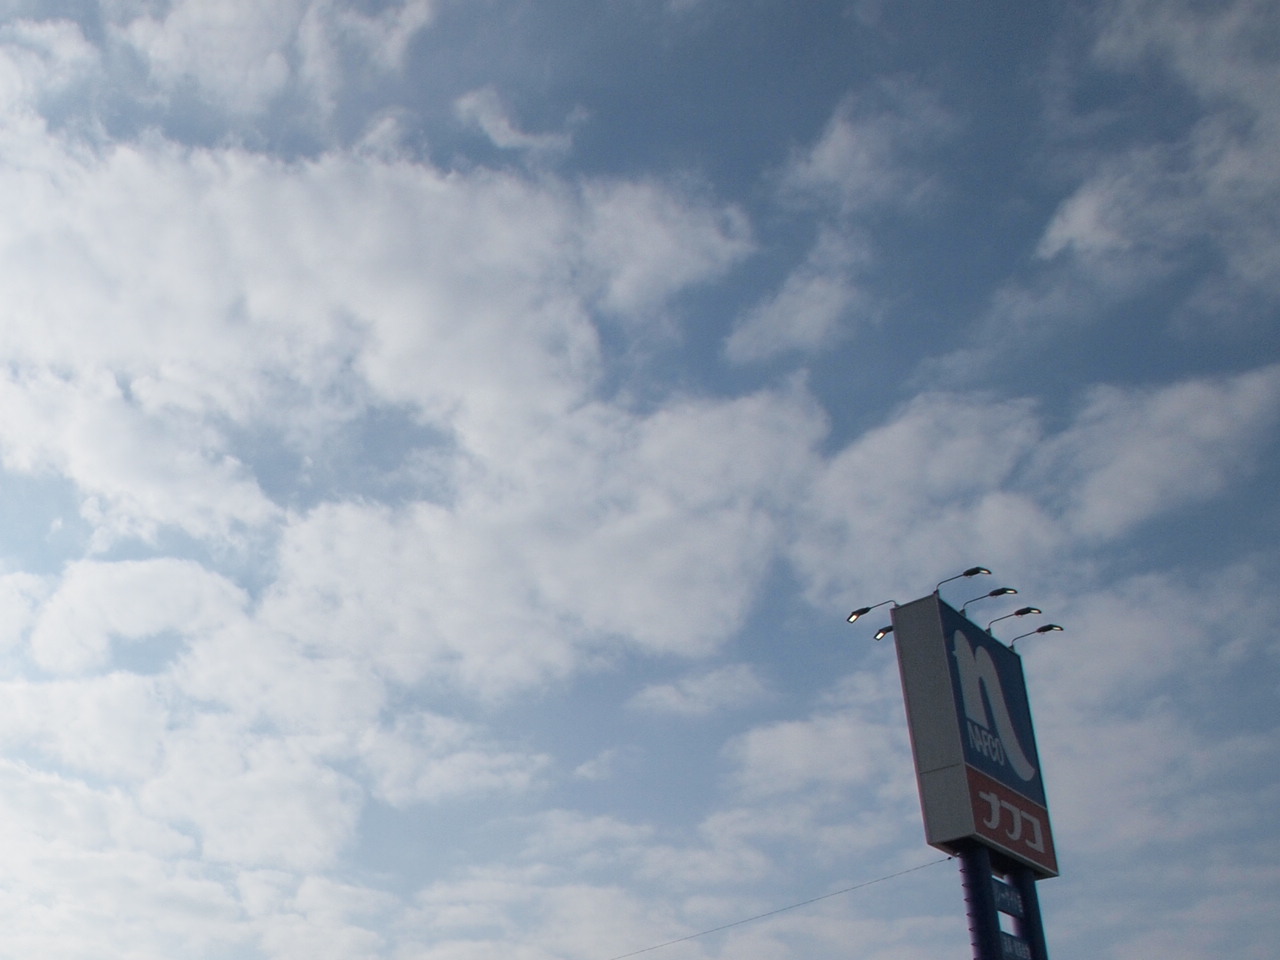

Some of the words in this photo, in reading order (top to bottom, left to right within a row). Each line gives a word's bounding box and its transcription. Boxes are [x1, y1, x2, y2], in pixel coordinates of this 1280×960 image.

[966, 721, 1005, 766] NAFCO
[978, 790, 1045, 853] ナフコ
